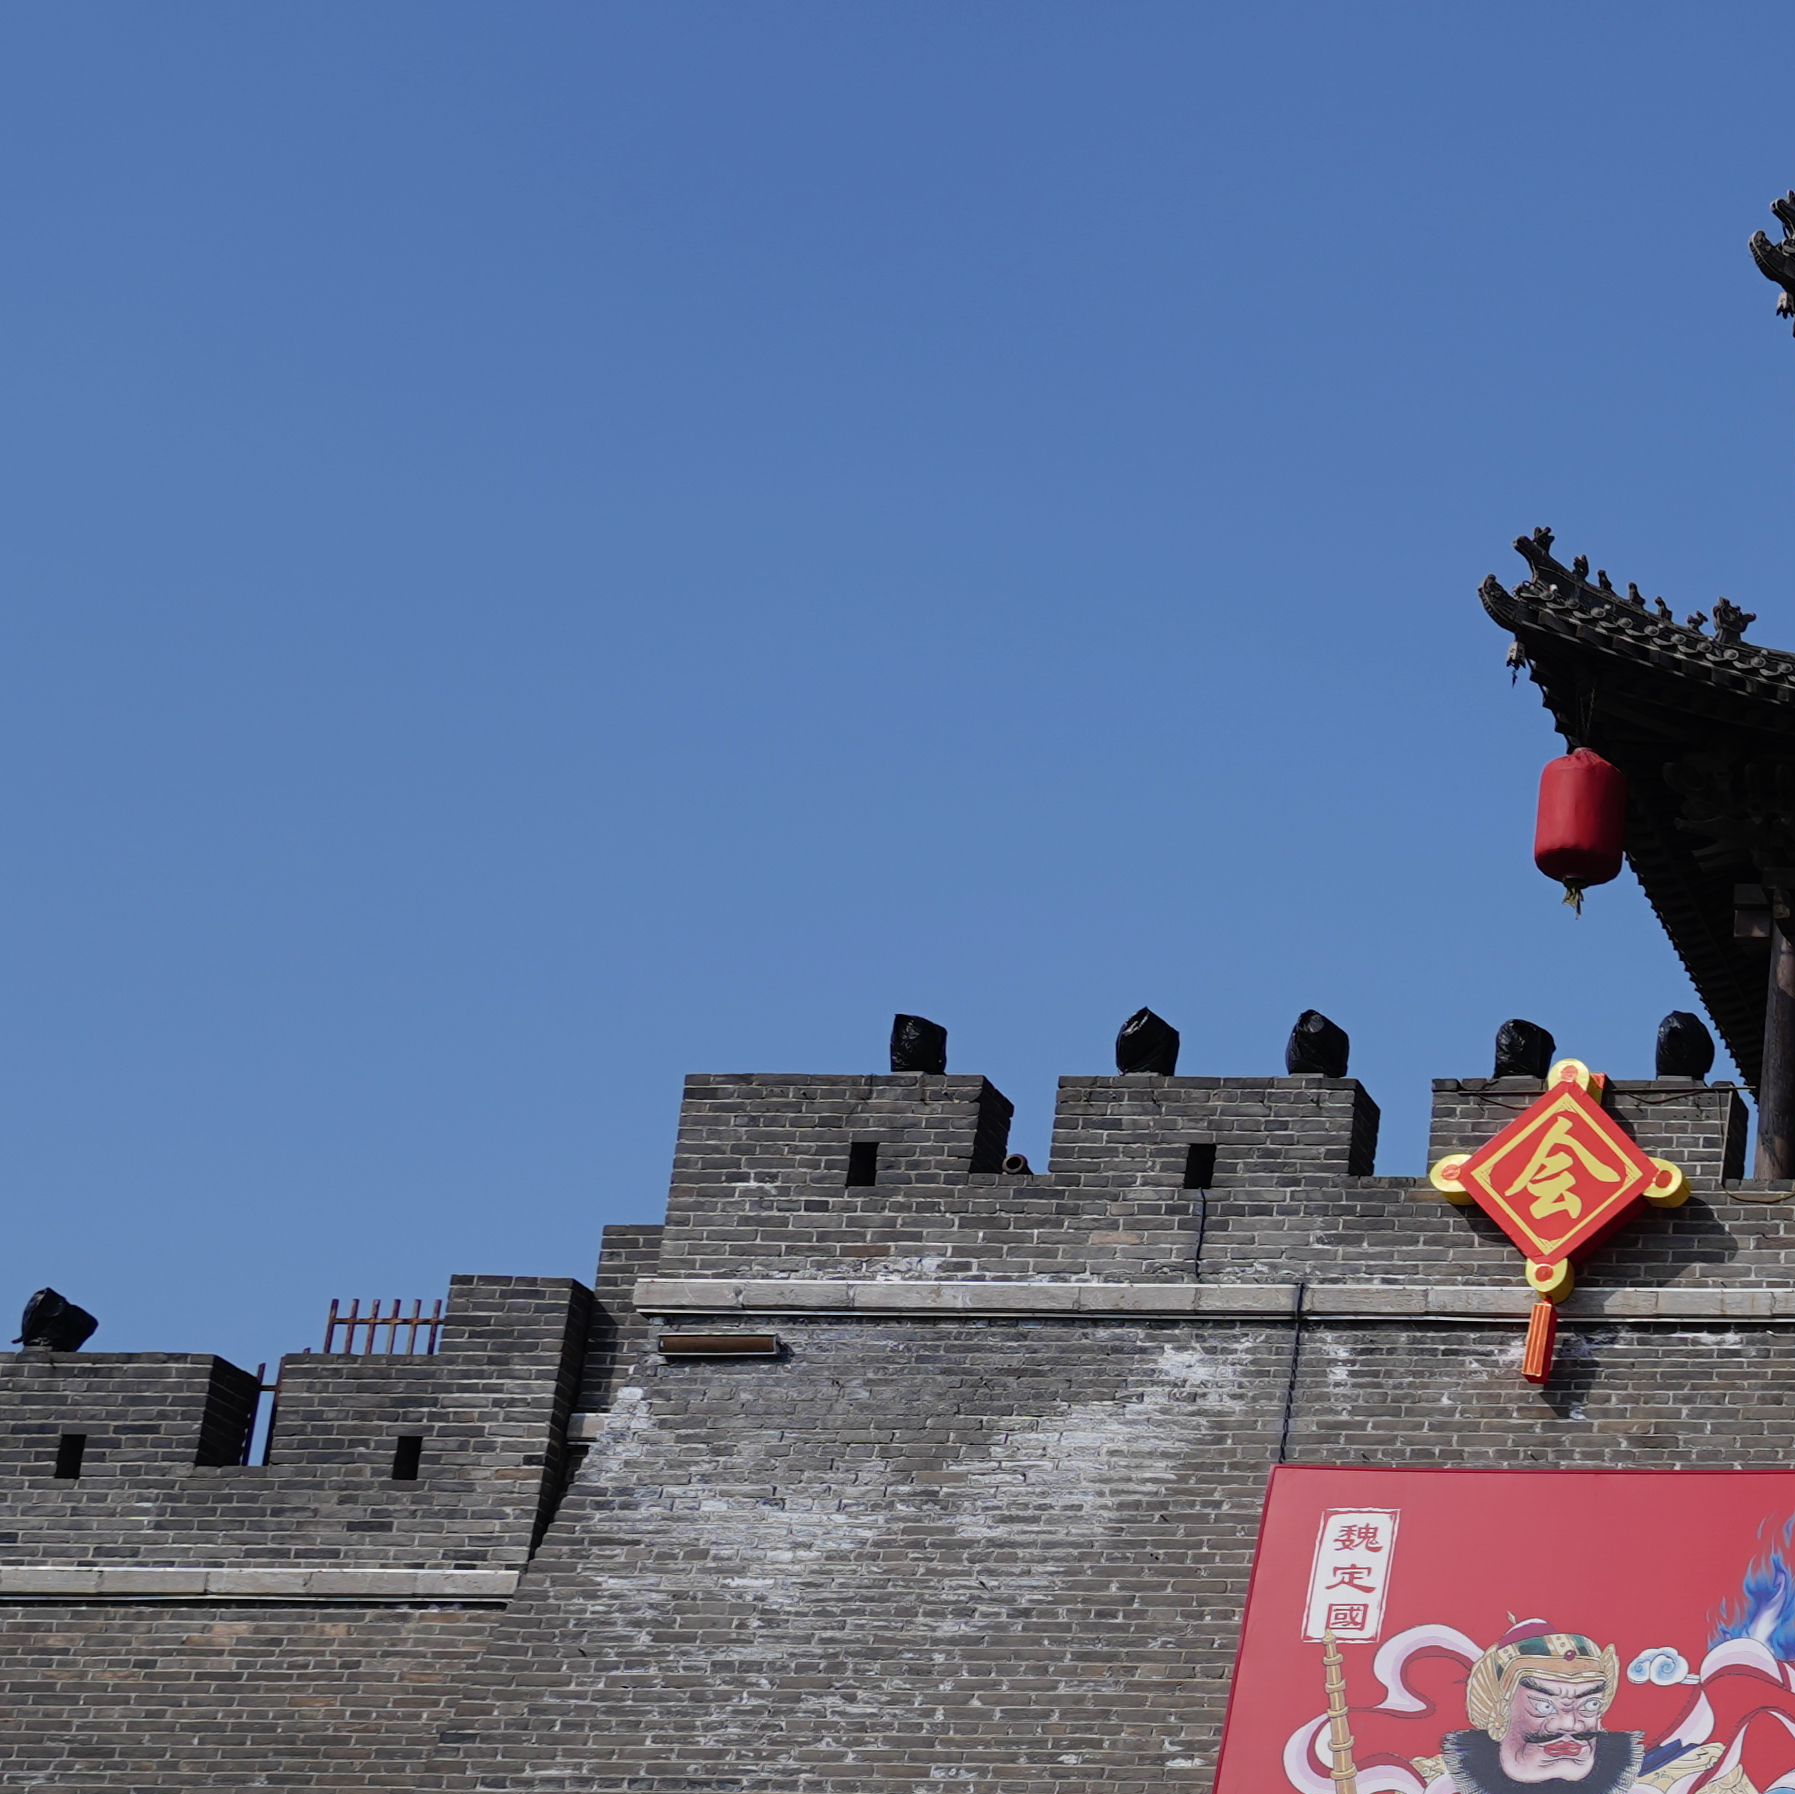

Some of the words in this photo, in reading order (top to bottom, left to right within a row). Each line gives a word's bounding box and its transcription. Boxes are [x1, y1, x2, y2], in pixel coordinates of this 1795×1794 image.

[1504, 1116, 1620, 1219] 会
[1325, 1523, 1384, 1632] 魏定國
